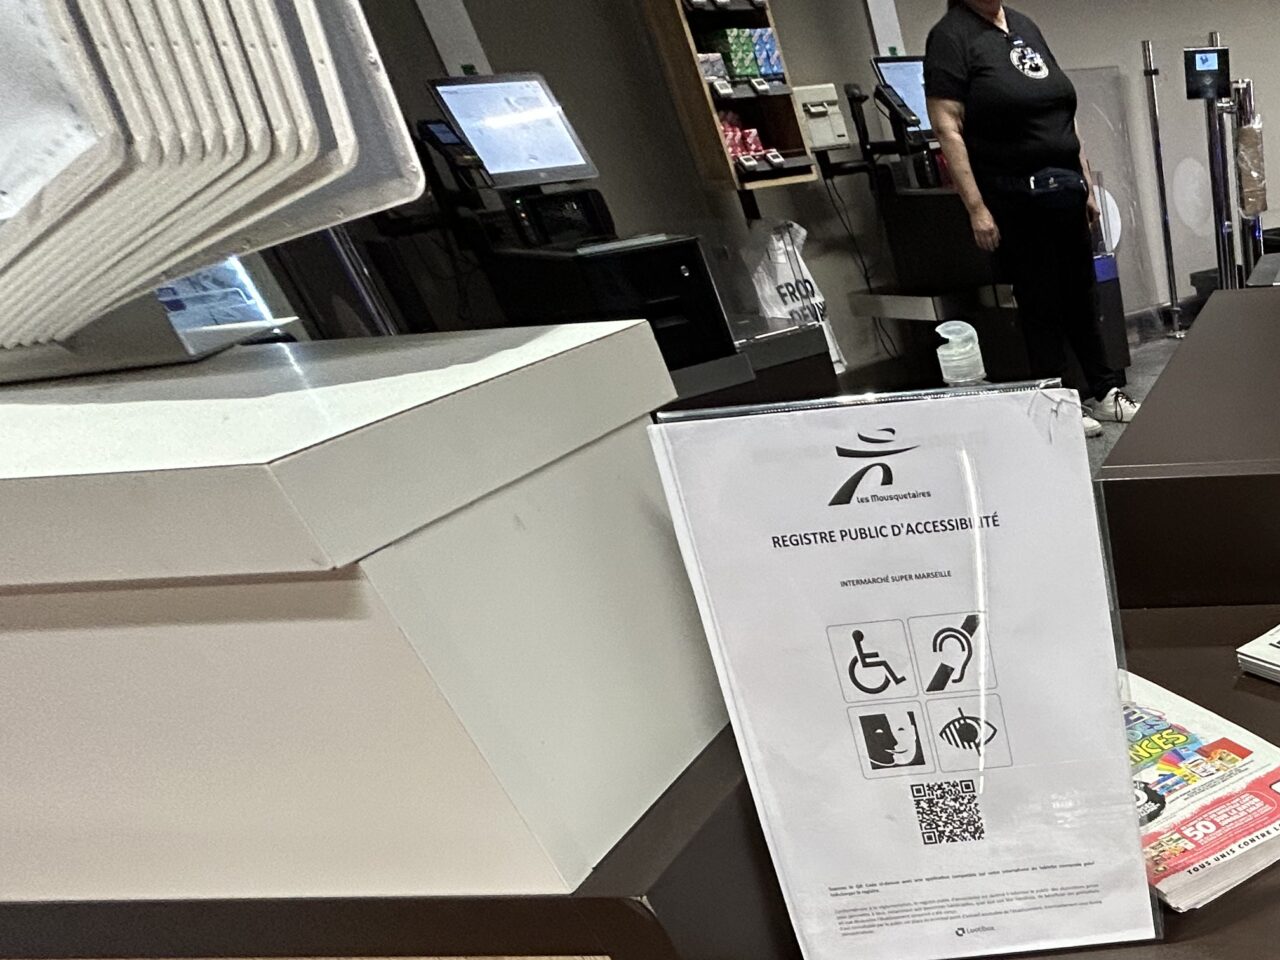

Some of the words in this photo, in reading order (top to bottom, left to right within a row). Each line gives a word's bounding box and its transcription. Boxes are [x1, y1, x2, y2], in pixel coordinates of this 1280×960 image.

[871, 490, 932, 503] Mousquetaires
[772, 530, 837, 549] REGISTRE
[840, 525, 889, 542] PUBLIC
[891, 511, 1001, 537] D'ACCESSIBIITÉ
[840, 574, 891, 588] INTERMARCHÉ
[891, 573, 914, 583] SUPER
[914, 570, 952, 581] MARSEILLE
[1182, 820, 1217, 841] 50
[1186, 860, 1212, 875] TOUS
[1213, 848, 1236, 863] UNIS
[1238, 830, 1271, 849] CONTRE
